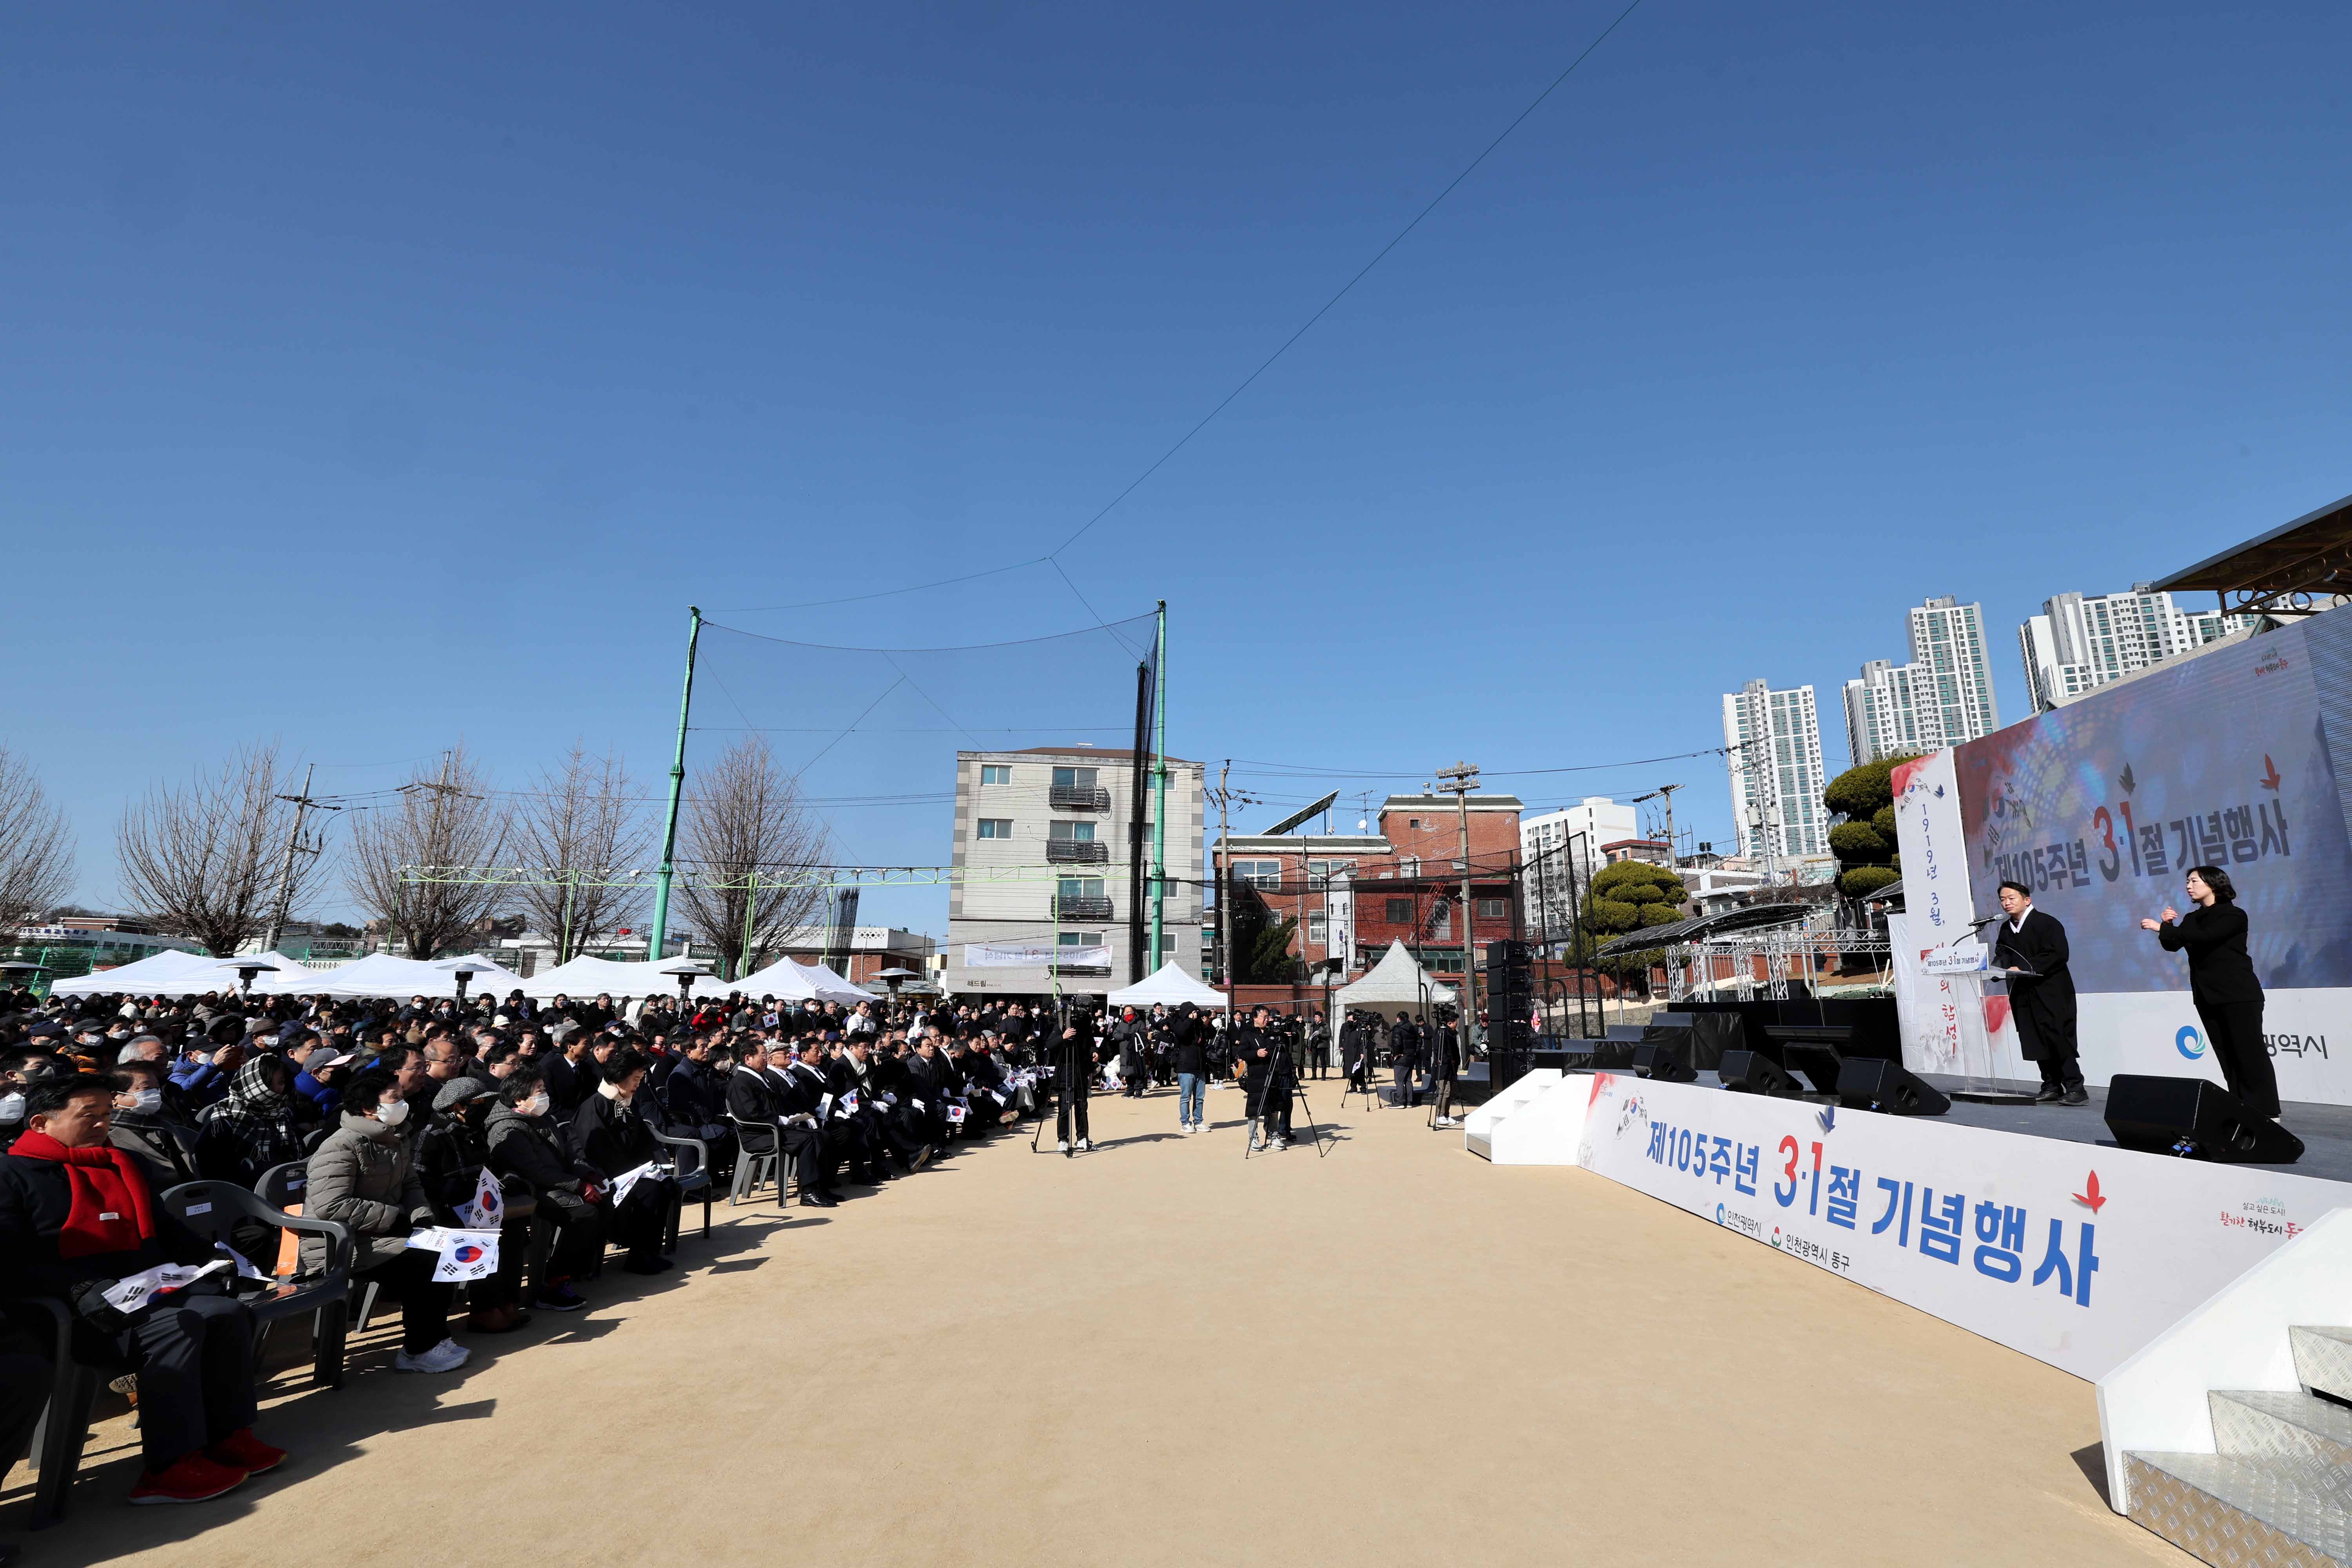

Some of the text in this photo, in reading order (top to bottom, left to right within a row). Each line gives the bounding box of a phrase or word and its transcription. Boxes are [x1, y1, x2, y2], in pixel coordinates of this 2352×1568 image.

[1922, 804, 1937, 880] 1919년
[1994, 838, 2091, 893] 제105주년
[2170, 799, 2291, 871] 기념행사
[1942, 1004, 1956, 1058] 함성!
[1647, 1121, 1759, 1197] 제105주년
[1871, 1176, 2100, 1308] 기념행사
[1728, 1210, 1761, 1237] 인천광역시
[2220, 1211, 2305, 1240] 활기찬 행복도시 동
[2242, 1202, 2285, 1216] 살고 싶은 도시!
[1787, 1234, 1850, 1272] 인천광역시 동구
